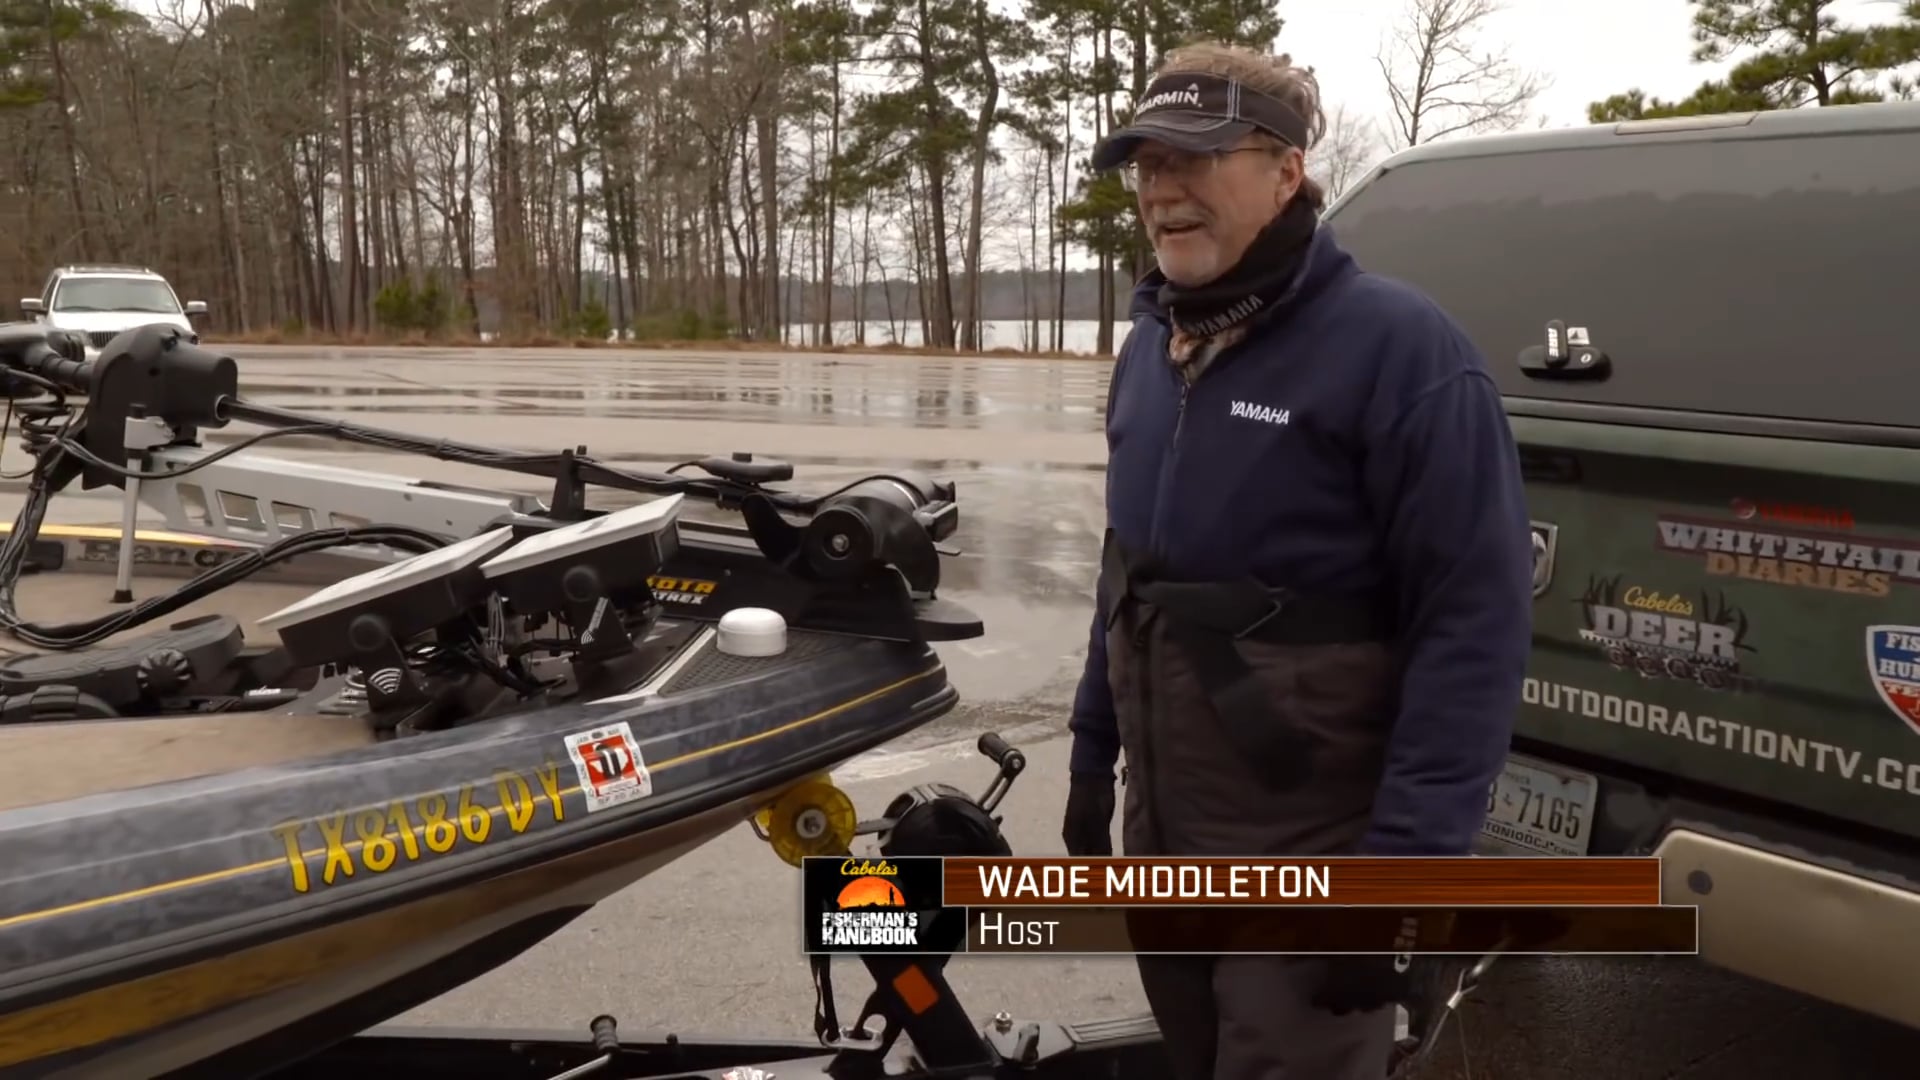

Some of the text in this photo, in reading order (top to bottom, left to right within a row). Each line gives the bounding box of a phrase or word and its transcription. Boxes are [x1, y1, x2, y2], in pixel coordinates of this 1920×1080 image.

[1230, 400, 1290, 425] YAMAHA
[1705, 551, 1890, 597] DIARIES
[1623, 586, 1694, 615] Cabela's
[1594, 604, 1738, 661] DEER
